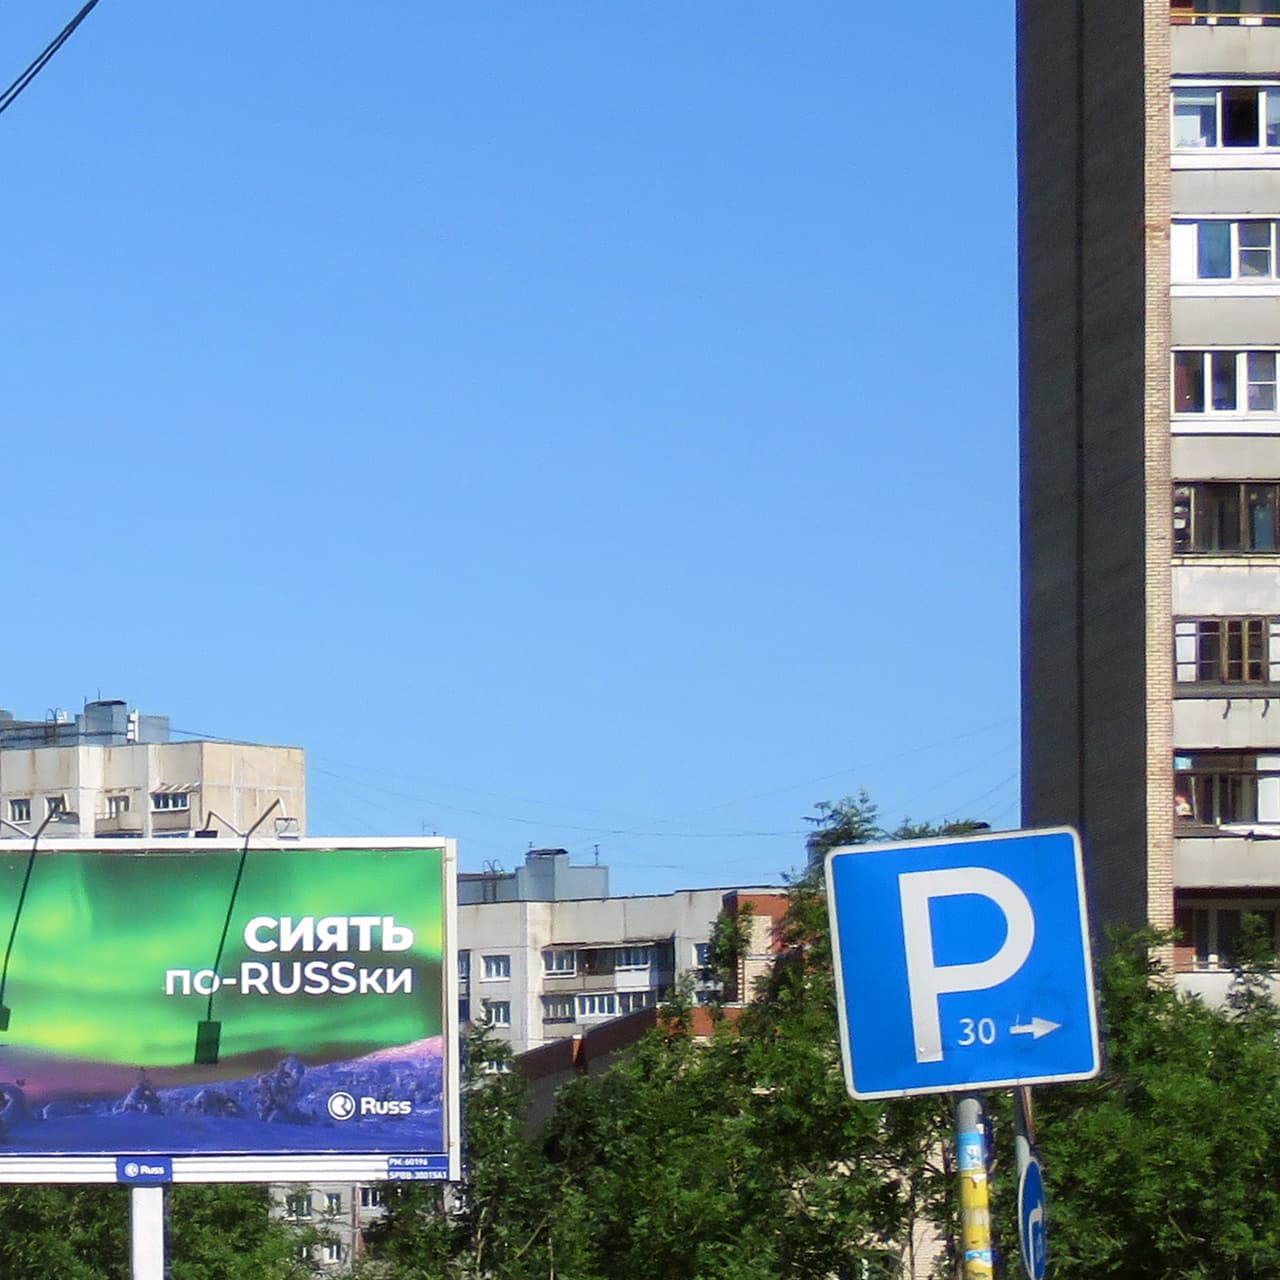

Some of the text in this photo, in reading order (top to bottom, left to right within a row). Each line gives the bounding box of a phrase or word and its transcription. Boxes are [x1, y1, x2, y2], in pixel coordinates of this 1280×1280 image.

[243, 916, 415, 953] СИЯТЬ
[898, 866, 1036, 1064] P
[957, 1018, 997, 1046] 30
[360, 1096, 412, 1115] Russ
